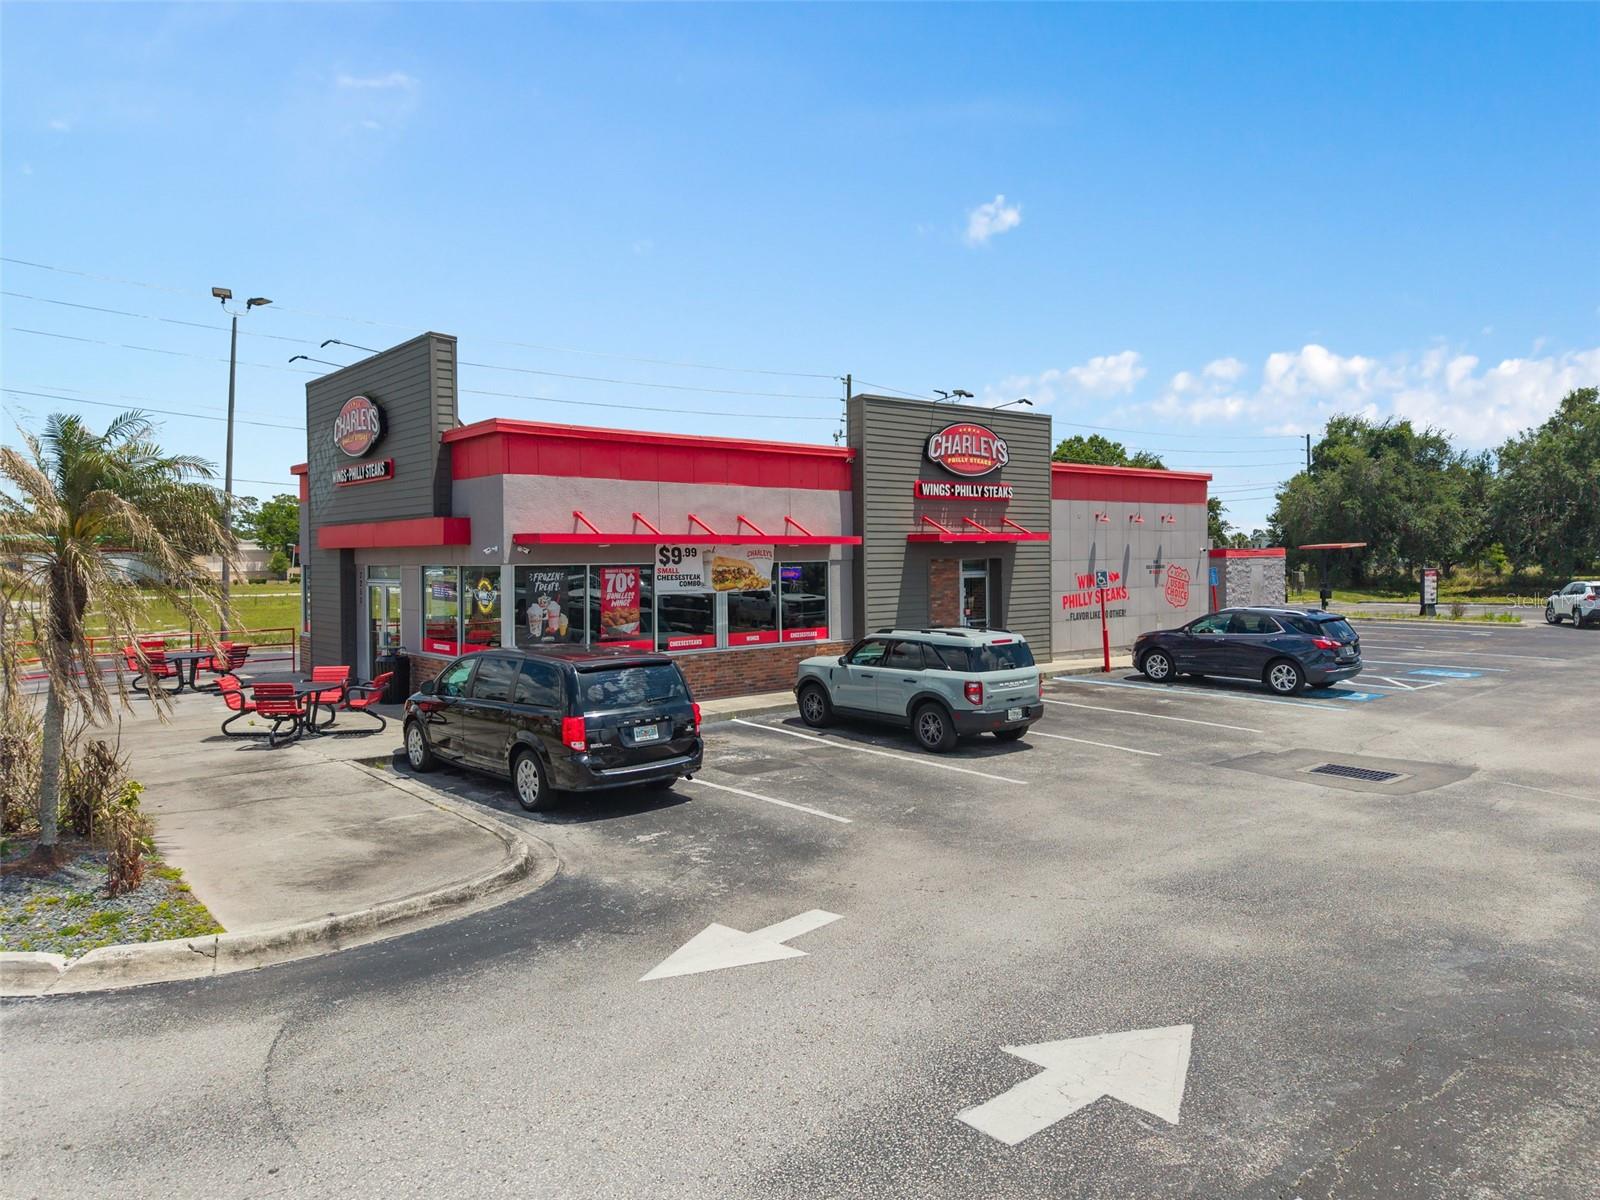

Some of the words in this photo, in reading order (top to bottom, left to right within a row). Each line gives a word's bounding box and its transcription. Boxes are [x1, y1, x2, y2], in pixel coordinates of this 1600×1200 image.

[334, 408, 378, 442] CHARLEYS
[930, 434, 1007, 463] CHARLEYS
[969, 457, 992, 466] STEAKS
[348, 464, 364, 481] PHILLY
[365, 461, 385, 478] STEAKS
[922, 483, 951, 496] WINGS
[954, 485, 983, 497] PHILLY
[983, 486, 1013, 498] STEAKS
[658, 545, 697, 567] $9.99
[533, 572, 560, 582] FROZEN
[605, 573, 635, 593] 70¢
[1170, 579, 1184, 589] USDA
[535, 581, 560, 592] TREATS
[1168, 587, 1188, 600] CHOICE
[1062, 591, 1092, 609] PHILLY
[1090, 611, 1100, 619] LIKE
